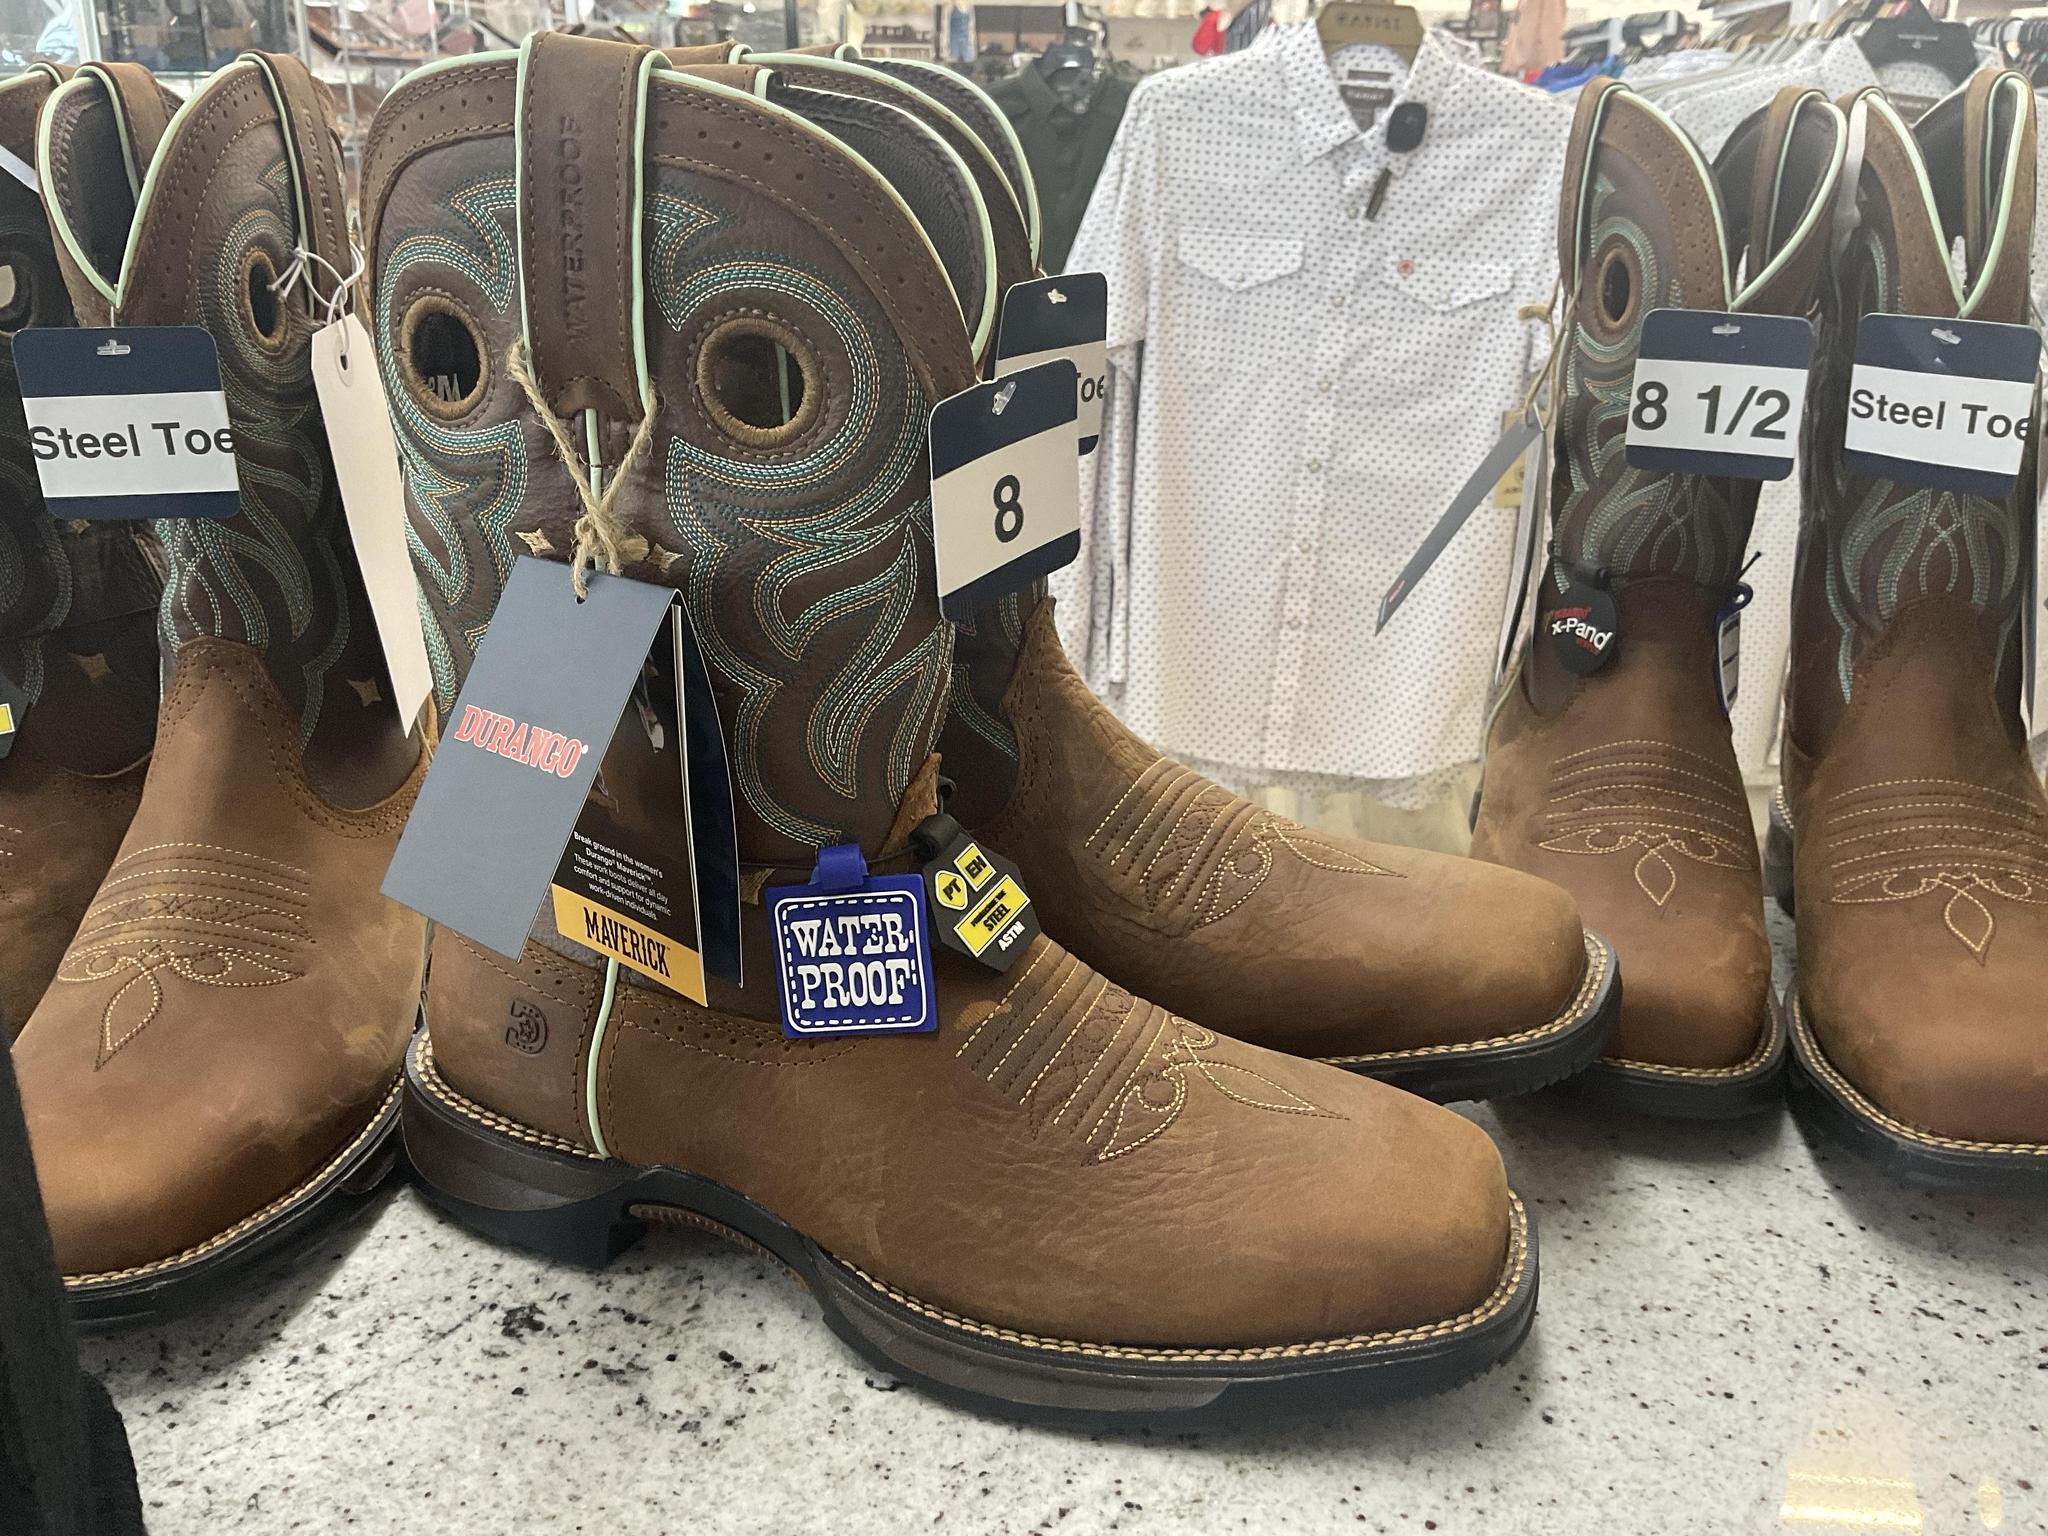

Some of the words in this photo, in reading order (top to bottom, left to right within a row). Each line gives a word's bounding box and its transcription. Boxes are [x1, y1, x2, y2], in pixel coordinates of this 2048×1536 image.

[559, 115, 589, 343] WATERPROOF
[1076, 372, 1104, 402] oe
[1631, 381, 1668, 431] 8
[1697, 385, 1790, 440] 1/2
[1851, 389, 1945, 430] Steel
[1962, 403, 2032, 441] Toe
[29, 424, 141, 460] Steel
[152, 421, 235, 456] Toe
[993, 474, 1024, 543] 8
[574, 831, 592, 846] Break
[593, 841, 615, 856] ground
[616, 850, 622, 860] in
[623, 853, 634, 865] the
[635, 860, 663, 878] women's
[965, 855, 987, 879] EH
[574, 853, 593, 868] These
[593, 864, 608, 876] work
[609, 869, 627, 884] boots
[656, 892, 668, 905] day
[574, 866, 598, 881] comfort
[598, 876, 611, 887] and
[611, 881, 635, 899] support
[635, 892, 644, 903] for
[645, 899, 671, 917] dynamic
[943, 878, 961, 901] PT
[790, 913, 908, 958] WATER
[983, 903, 1011, 931] STEEL
[998, 921, 1025, 951] ASTM
[797, 958, 910, 1009] PROOF
